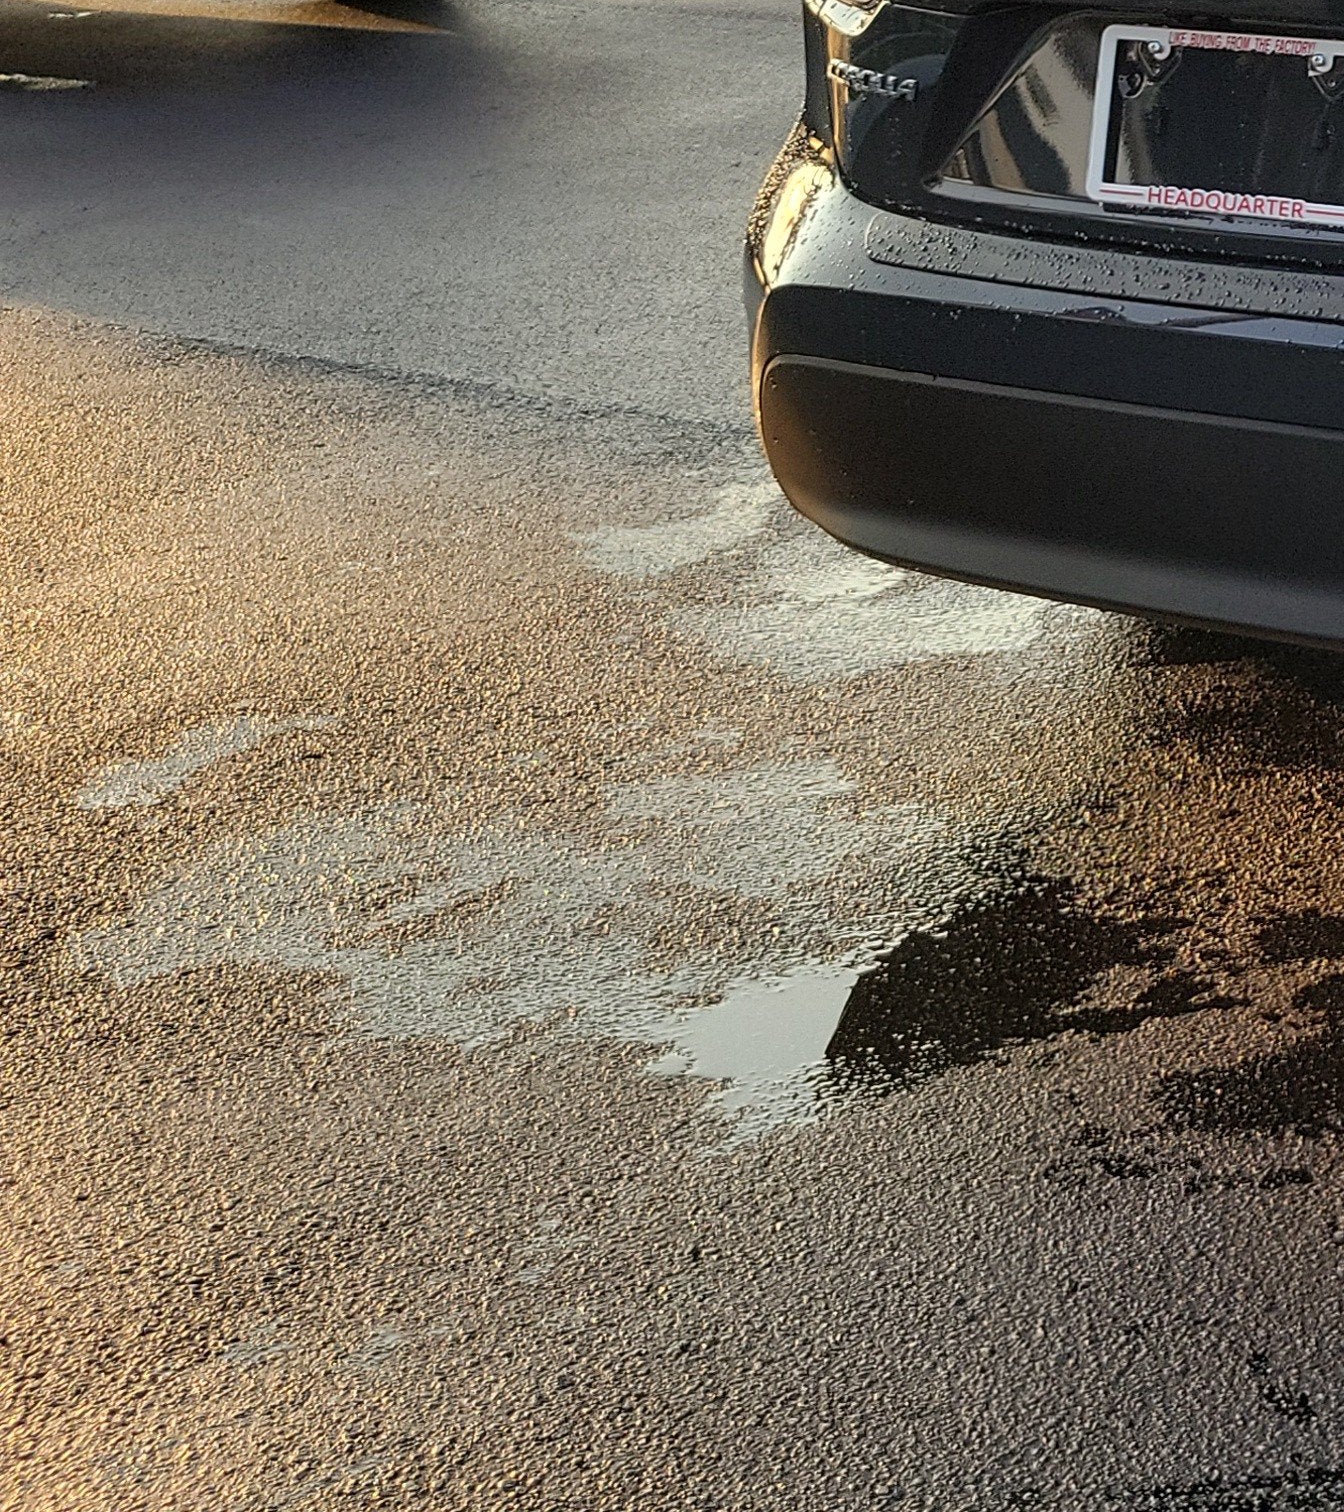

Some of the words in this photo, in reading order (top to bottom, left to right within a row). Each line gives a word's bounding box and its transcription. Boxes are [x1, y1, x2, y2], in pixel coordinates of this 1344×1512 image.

[1169, 31, 1186, 45] LIKE
[1190, 33, 1222, 48] BUYING
[1226, 36, 1249, 50] FROM
[1255, 38, 1270, 53] THE
[1275, 40, 1316, 55] FACTORY!
[1148, 189, 1304, 218] HEADQUARTER
